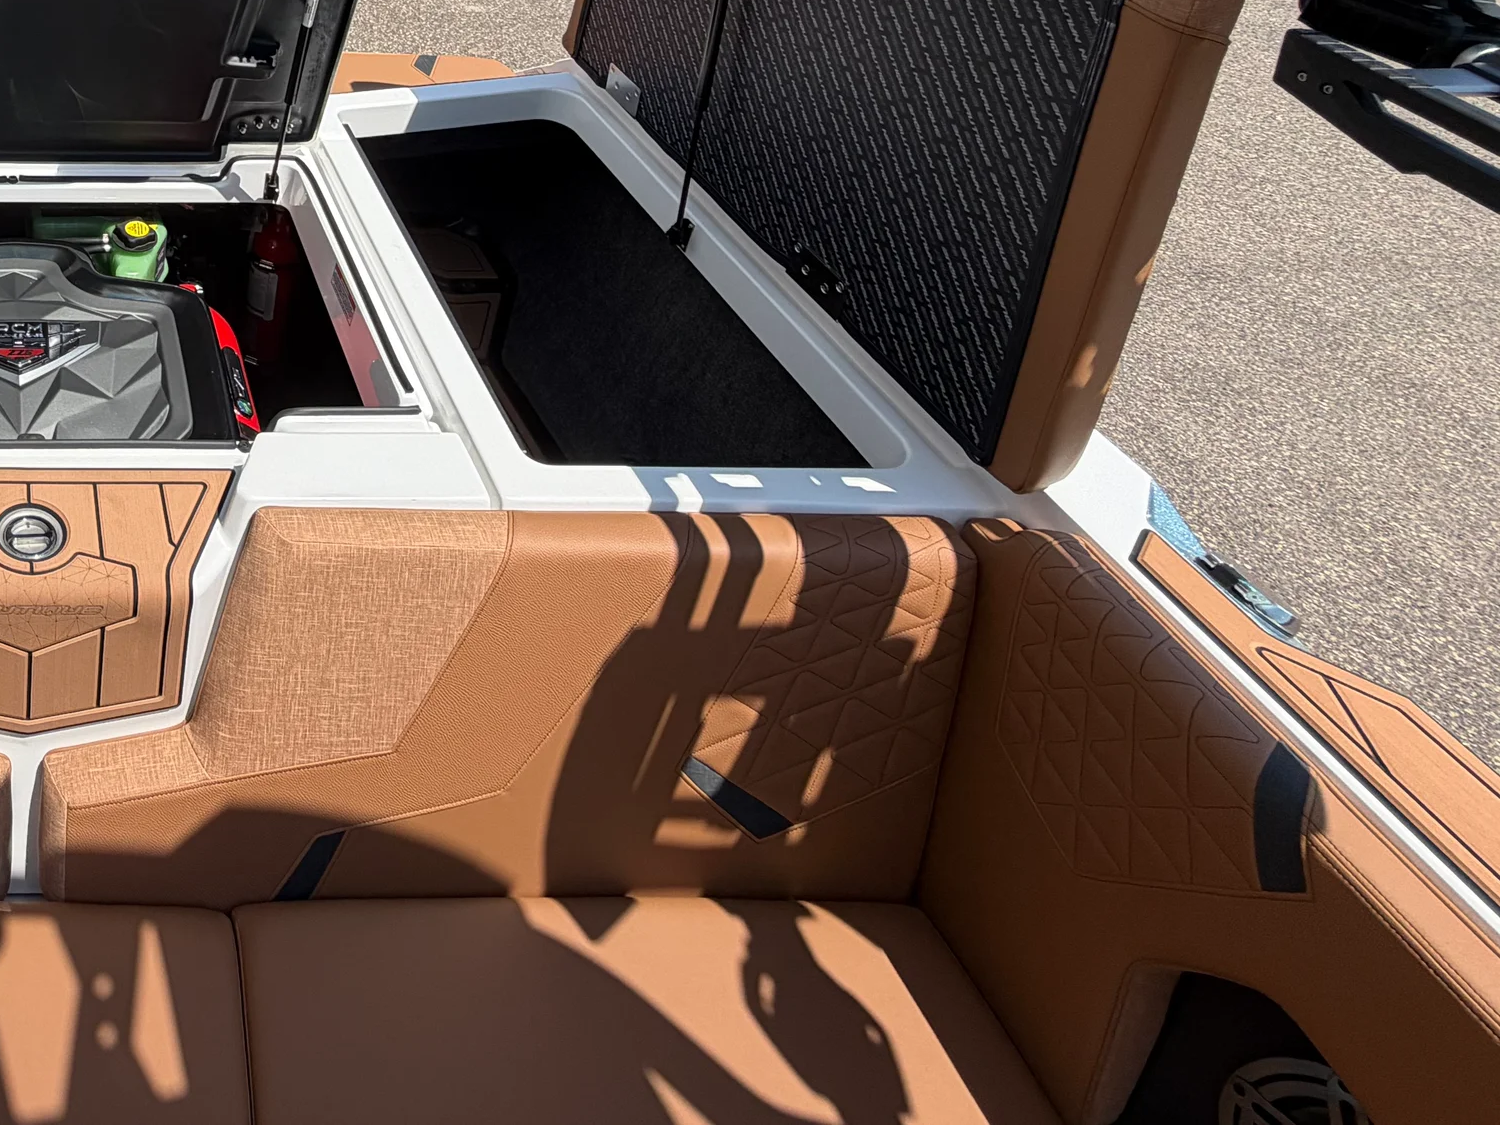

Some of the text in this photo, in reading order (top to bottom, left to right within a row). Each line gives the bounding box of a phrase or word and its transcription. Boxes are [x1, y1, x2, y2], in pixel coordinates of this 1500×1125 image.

[949, 15, 980, 83] NAUTIQUE
[977, 87, 1009, 158] NAUTIQUE
[988, 61, 1021, 132] NAUTIQUE
[1009, 57, 1043, 130] NAUTIQUE
[1018, 22, 1052, 96] NAUTIQUE
[1033, 0, 1068, 73] NAUTIQUE
[888, 5, 998, 289] NAUTIQUE NAUTIQUE NAUTIQUE NAUTIQUE
[924, 51, 952, 118] NAUTIQUE
[951, 123, 981, 193] NAUTIQUE
[979, 197, 1011, 270] NAUTIQUE
[933, 25, 962, 92] NAUTIQUE
[960, 96, 991, 166] NAUTIQUE
[989, 171, 1022, 245] NAUTIQUE
[906, 102, 990, 319] NAUTIQUE NAUTIQUE NAUTIQUE
[914, 173, 971, 317] NAUTIQUE NAUTIQUE
[931, 268, 960, 339] NAUTIQUE
